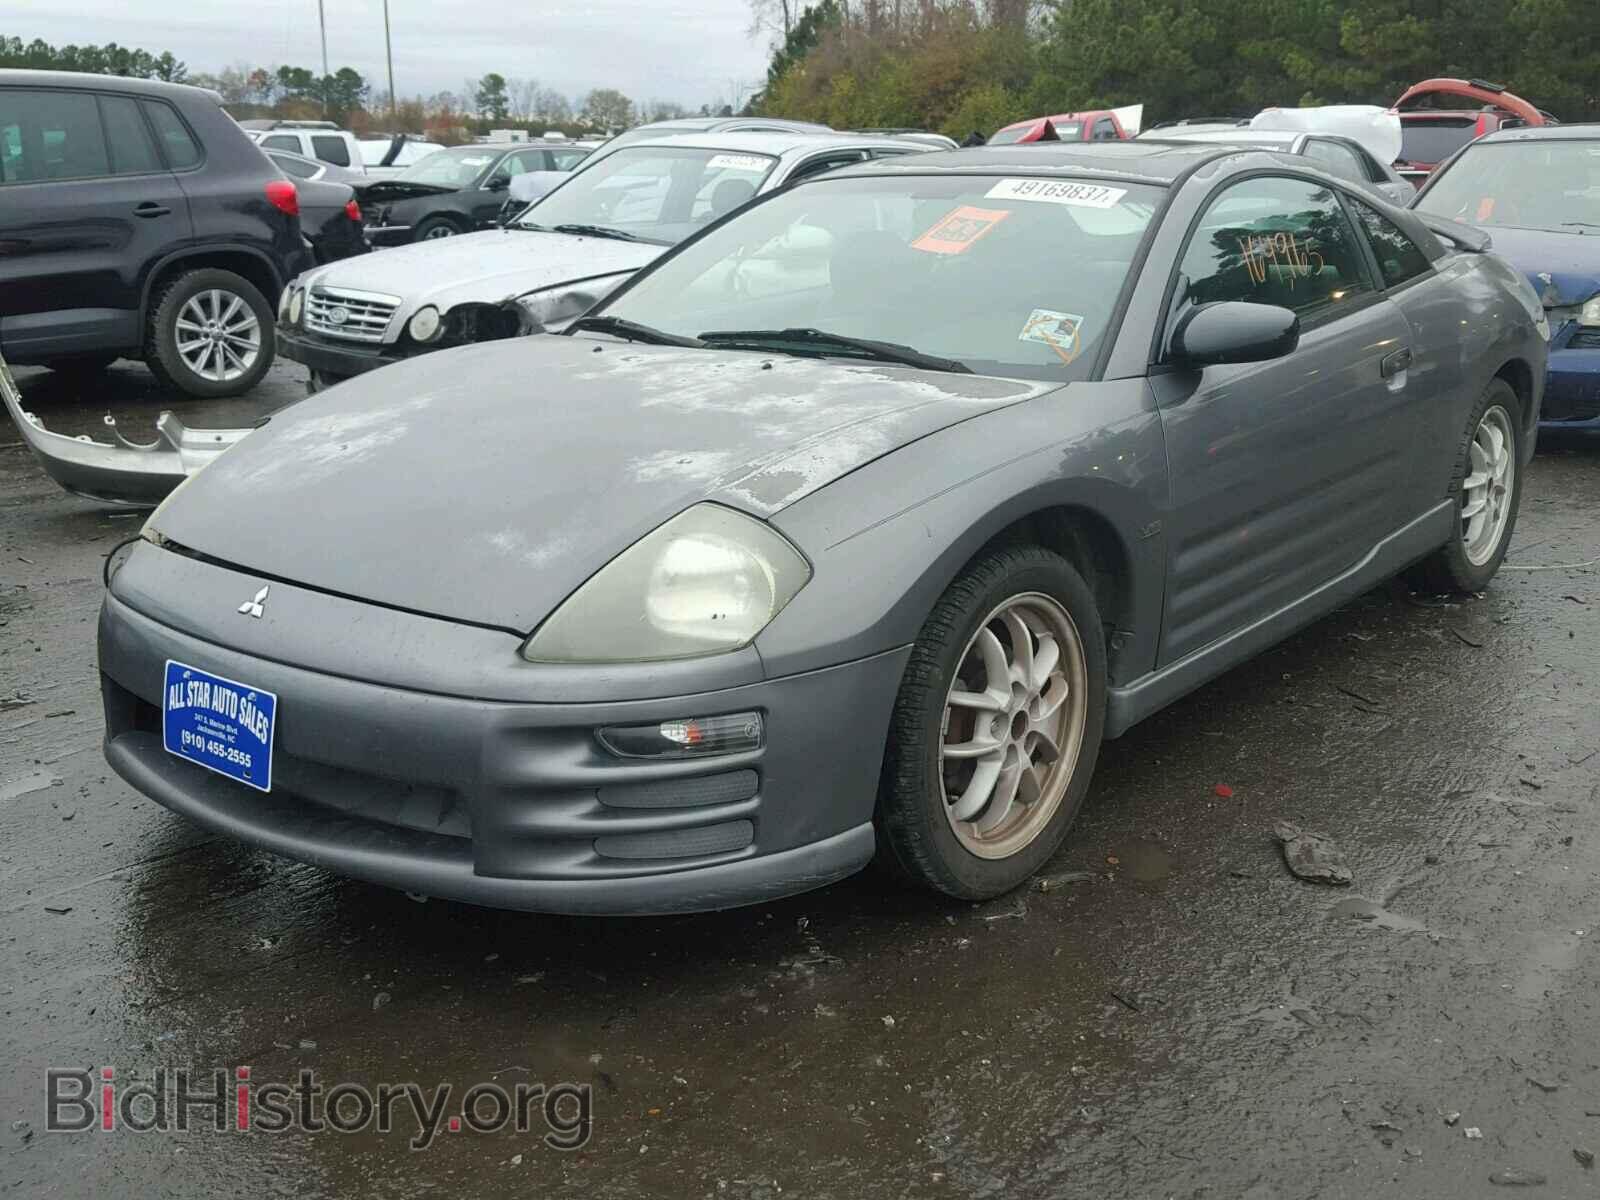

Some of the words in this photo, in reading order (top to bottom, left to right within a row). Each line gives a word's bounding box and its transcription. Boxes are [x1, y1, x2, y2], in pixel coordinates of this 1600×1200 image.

[169, 682, 185, 711] ALL
[187, 680, 210, 709] STAR
[212, 685, 238, 720] AUTO
[239, 697, 269, 745] SALES
[181, 729, 206, 753] (910)
[207, 740, 252, 768] 455-2555
